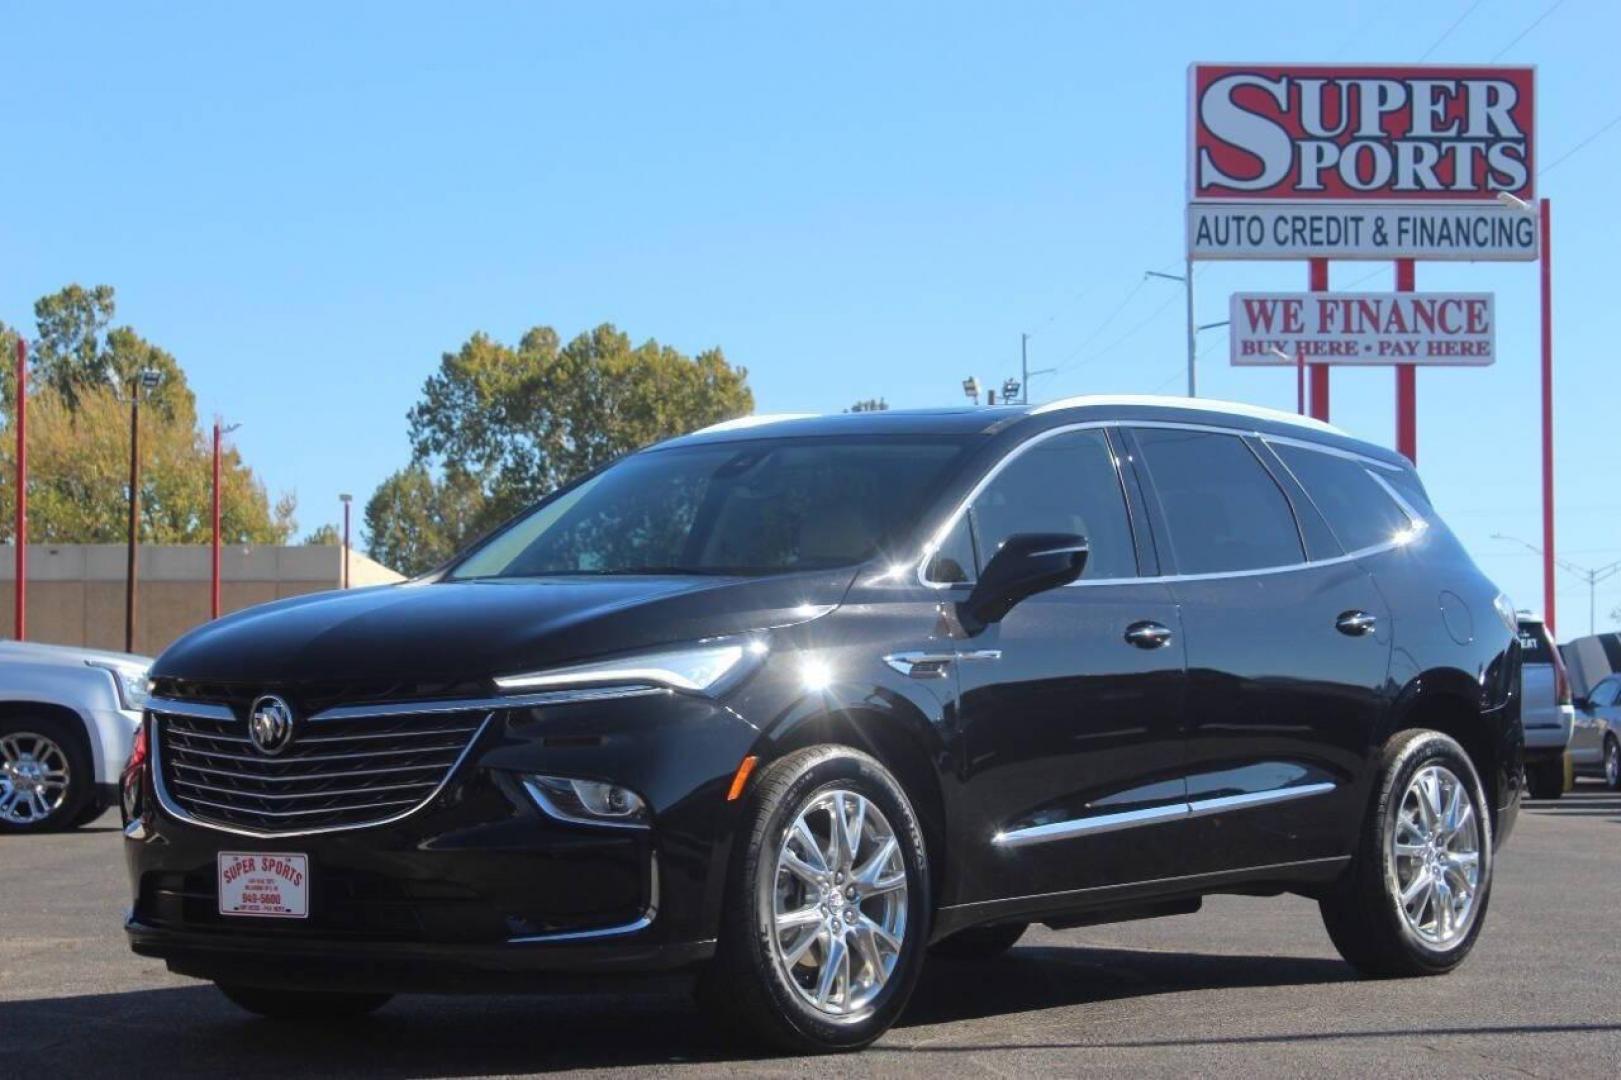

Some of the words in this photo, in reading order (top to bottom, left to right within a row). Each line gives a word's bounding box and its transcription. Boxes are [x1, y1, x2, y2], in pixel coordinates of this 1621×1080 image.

[1196, 215, 1264, 247] AUTO
[1273, 215, 1364, 247] CREDIT
[1372, 216, 1389, 247] &
[1398, 216, 1534, 248] FINANCING
[1241, 298, 1305, 334] WE
[1316, 298, 1490, 335] FINANCE
[1241, 340, 1289, 356] BUY
[1294, 340, 1359, 356] HERE
[1378, 340, 1420, 357] PAY
[1427, 340, 1490, 357] HERE
[224, 857, 256, 884] SUPER
[261, 857, 303, 887] SPORTS
